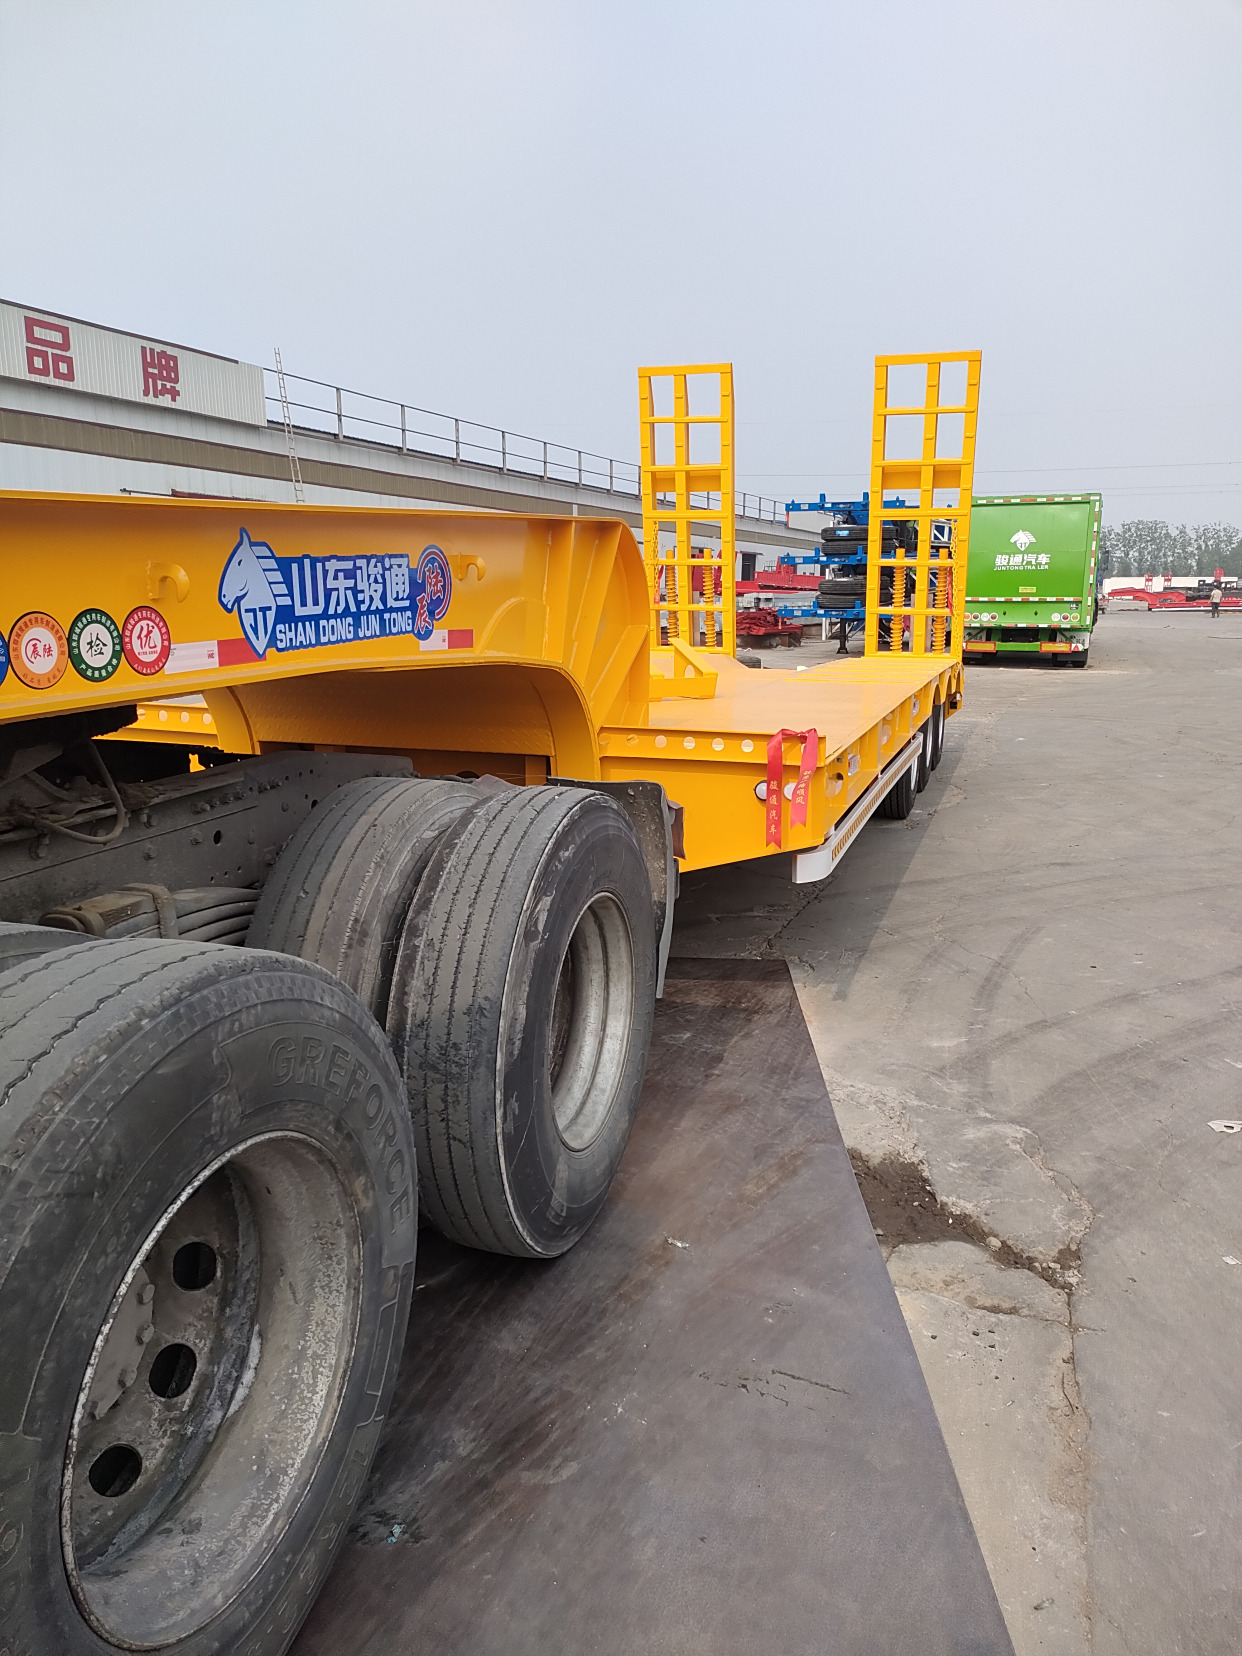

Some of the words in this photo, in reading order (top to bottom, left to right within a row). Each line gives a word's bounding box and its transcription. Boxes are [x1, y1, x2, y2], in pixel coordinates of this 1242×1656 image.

[994, 553, 1051, 566] 骏通汽车
[291, 558, 410, 617] 山东骏通
[86, 632, 108, 658] 检
[136, 622, 158, 651] 优
[276, 620, 316, 649] SHAN
[319, 616, 353, 643] DONG
[358, 613, 380, 637] JUN
[383, 610, 413, 634] TONG
[769, 780, 779, 836] 骏通汽车
